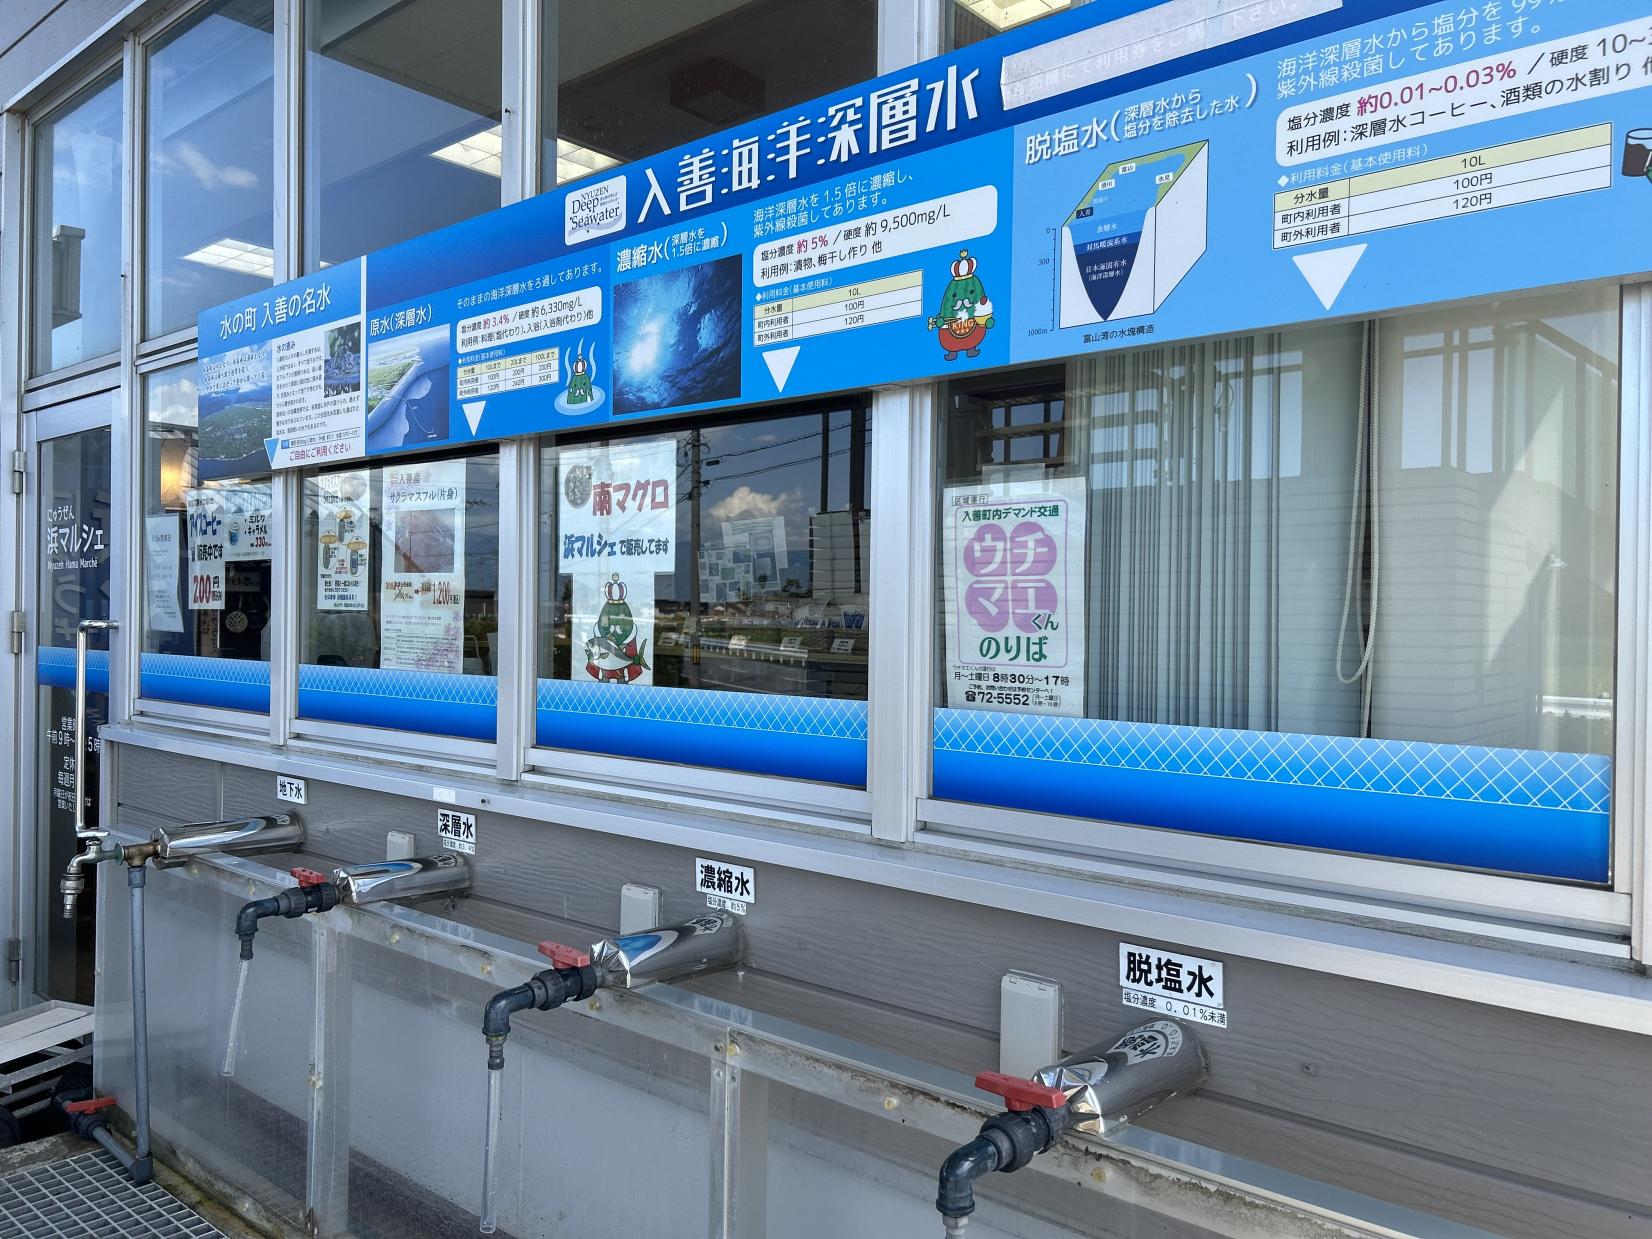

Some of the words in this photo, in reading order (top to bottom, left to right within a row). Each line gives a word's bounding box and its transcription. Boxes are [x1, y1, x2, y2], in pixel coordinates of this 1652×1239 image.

[1277, 2, 1503, 78] 海洋深層水から塩分を
[1277, 16, 1541, 99] 紫外線殺菌してあります。
[1287, 104, 1351, 131] 塩分濃度
[1550, 44, 1589, 68] 硬度
[1124, 89, 1201, 122] 深層水から
[1124, 96, 1239, 139] 塩分を除去した水
[637, 65, 980, 224] 入善海洋深層水
[1024, 117, 1107, 165] 脱塩水
[581, 186, 609, 200] NYUZEN
[1293, 187, 1329, 205] 分水量
[1460, 156, 1486, 168] 10L
[572, 198, 599, 214] Deep
[753, 194, 819, 223] 海洋深層水を
[1281, 203, 1342, 225] 町内利用者
[1453, 172, 1493, 190] 100円
[570, 207, 620, 230] Seawater
[753, 192, 887, 238] 紫外線殺菌してあります。
[1281, 222, 1341, 243] 町外利用者
[1453, 193, 1492, 210] 120円
[672, 228, 704, 246] 深層水を
[616, 241, 663, 272] 濃縮水
[761, 244, 794, 261] 塩分濃度
[219, 307, 258, 340] 水の町
[261, 283, 331, 329] 入善の名水
[757, 317, 789, 329] 町内利用者
[844, 301, 864, 311] 100円
[764, 303, 782, 314] 分水量
[848, 287, 861, 297] 10L
[370, 304, 433, 336] 原水(深層水)
[757, 330, 789, 342] 町外利用者
[844, 315, 864, 326] 120円
[952, 319, 974, 330] KING
[1083, 325, 1155, 344] 富山湾の水塊構造
[289, 443, 351, 461] ご自由にご利用ください
[592, 479, 669, 516] 南マグロ
[962, 505, 1060, 522] 入善町内デマンド交通
[563, 533, 616, 559] 浜マルシェ
[193, 574, 212, 604] 200
[979, 635, 1048, 662] のりば
[279, 780, 303, 799] 地下水
[439, 812, 474, 839] 深層水
[700, 863, 751, 896] 濃縮水
[1125, 951, 1215, 999] 脱塩水
[1123, 992, 1157, 1009] 塩分濃度
